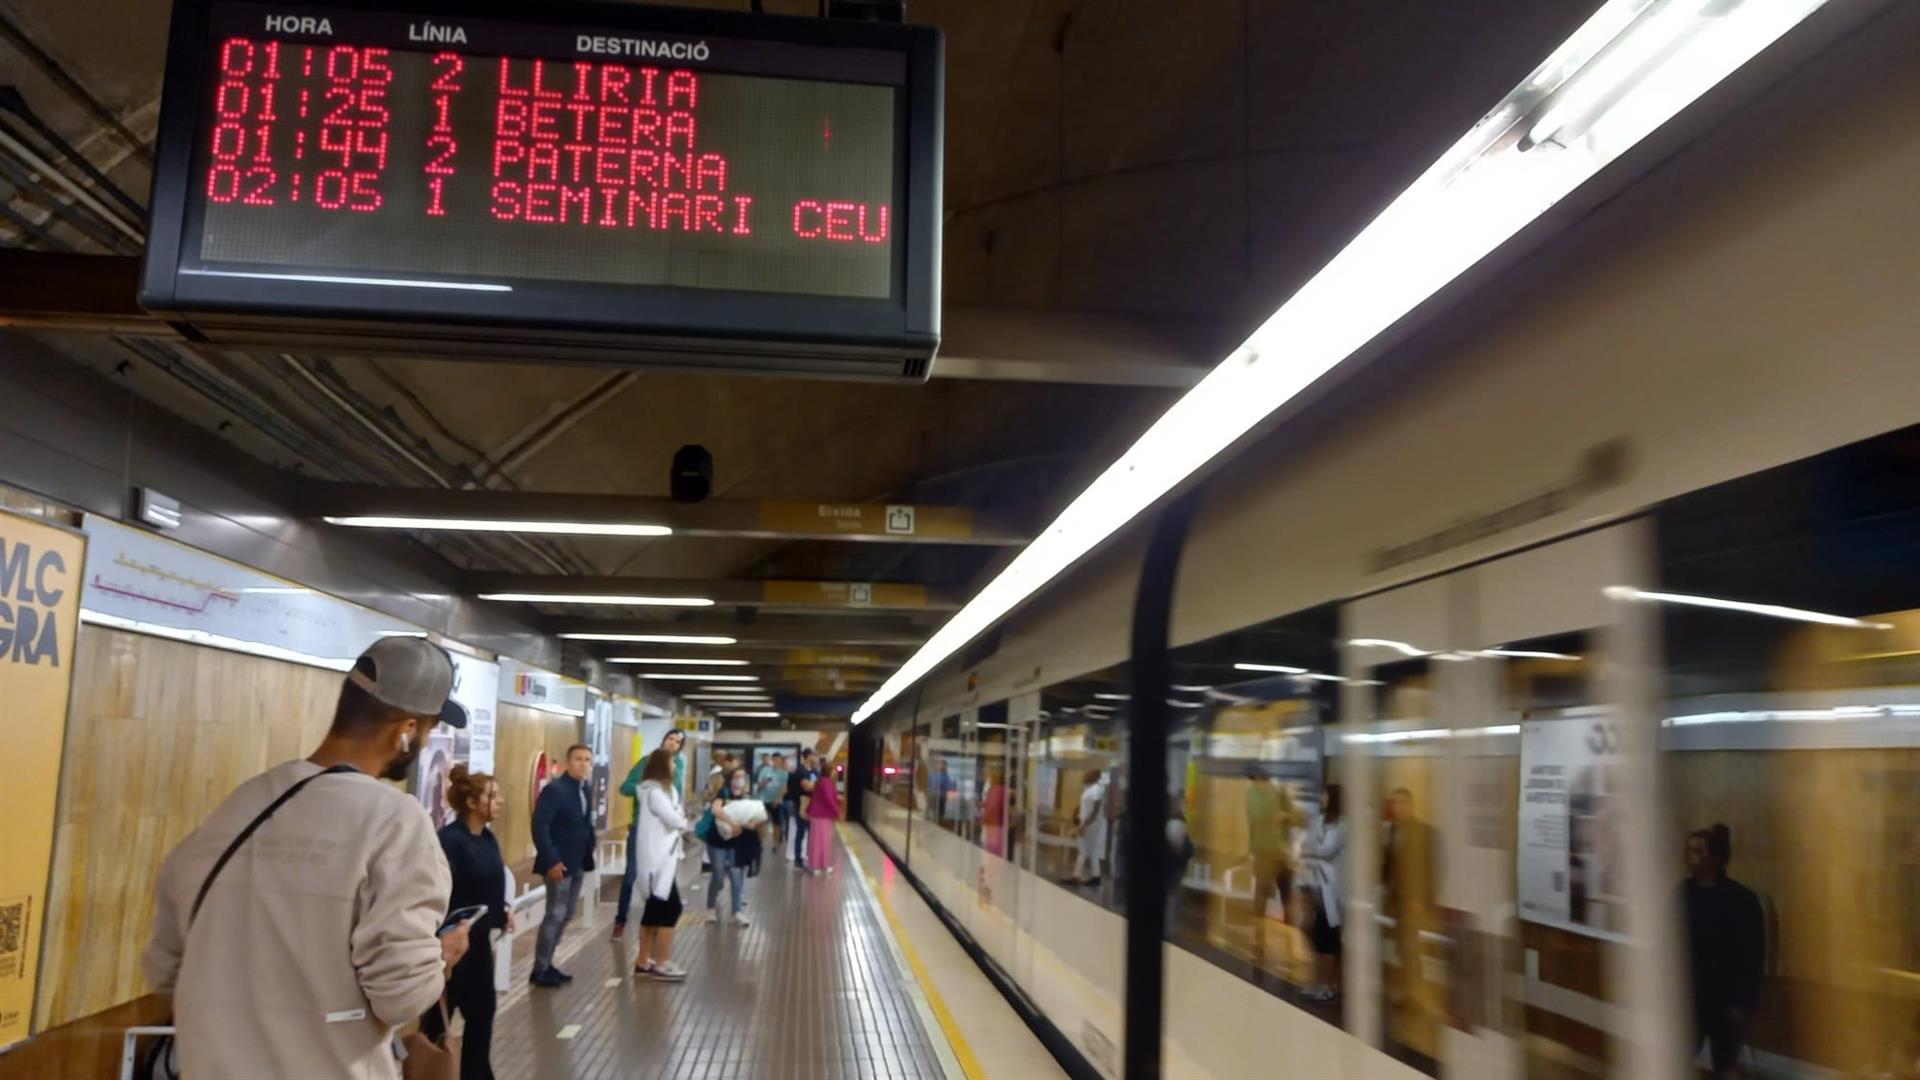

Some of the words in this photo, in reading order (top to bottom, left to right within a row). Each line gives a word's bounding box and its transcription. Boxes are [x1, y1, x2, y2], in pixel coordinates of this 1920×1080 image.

[265, 15, 333, 35] HORA
[409, 21, 468, 43] LÍNIA
[576, 35, 710, 61] DESTINACIÓ
[222, 38, 393, 86] 01:05
[431, 53, 463, 91] 2
[500, 56, 697, 109] LLIRIA
[217, 80, 389, 128] 01:25
[433, 95, 452, 132] 1
[496, 98, 695, 149] BETERA
[213, 122, 388, 169] 01:44
[425, 135, 457, 174] 2
[494, 139, 727, 192] PATERNA
[208, 164, 383, 211] 02:05
[427, 177, 445, 215] 1
[491, 180, 753, 235] SEMINARI
[793, 199, 889, 243] CEU
